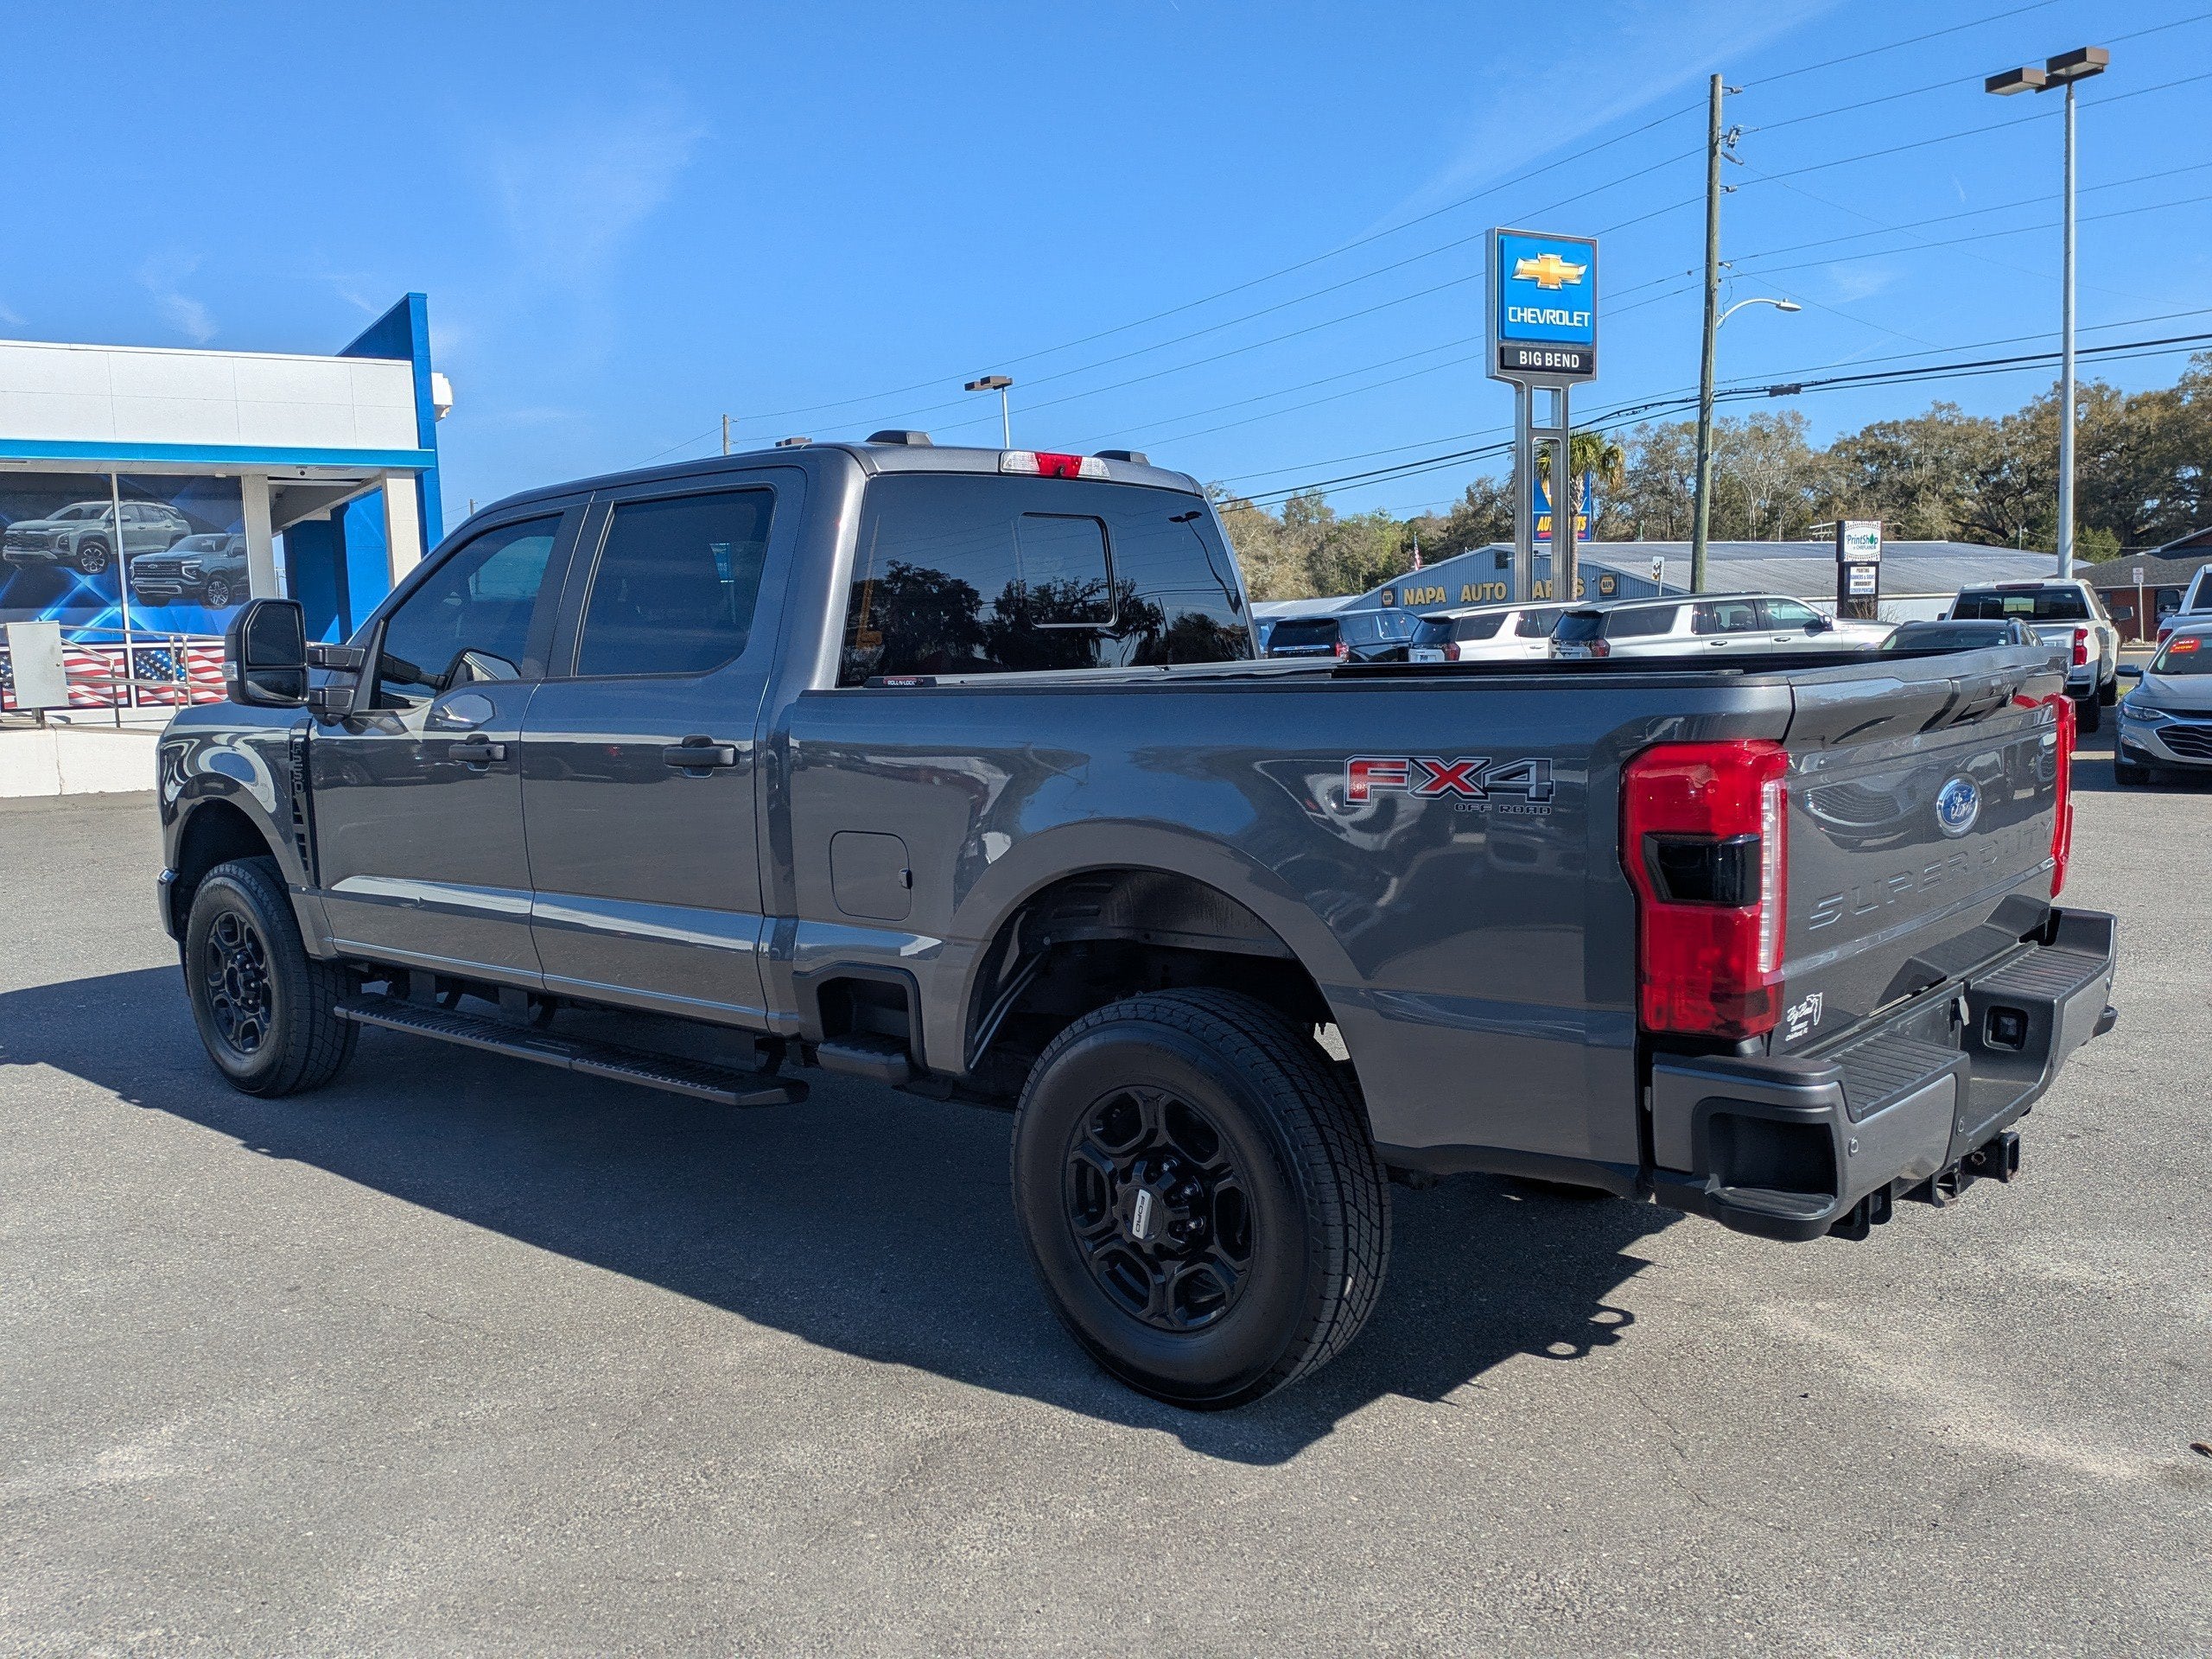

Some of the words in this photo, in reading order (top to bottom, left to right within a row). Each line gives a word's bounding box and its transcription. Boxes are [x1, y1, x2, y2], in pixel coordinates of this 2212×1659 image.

[1508, 307, 1591, 327] CHEVROLET
[1519, 351, 1542, 366] BIG
[1545, 352, 1580, 368] BEND
[1404, 586, 1446, 606] NAPA
[1460, 582, 1507, 602] AUTO
[1344, 754, 1555, 807] FX4
[1453, 803, 1492, 813] OFF
[1499, 804, 1552, 816] ROAD
[1809, 850, 1969, 931] SUPER
[1135, 1195, 1146, 1233] FORD
